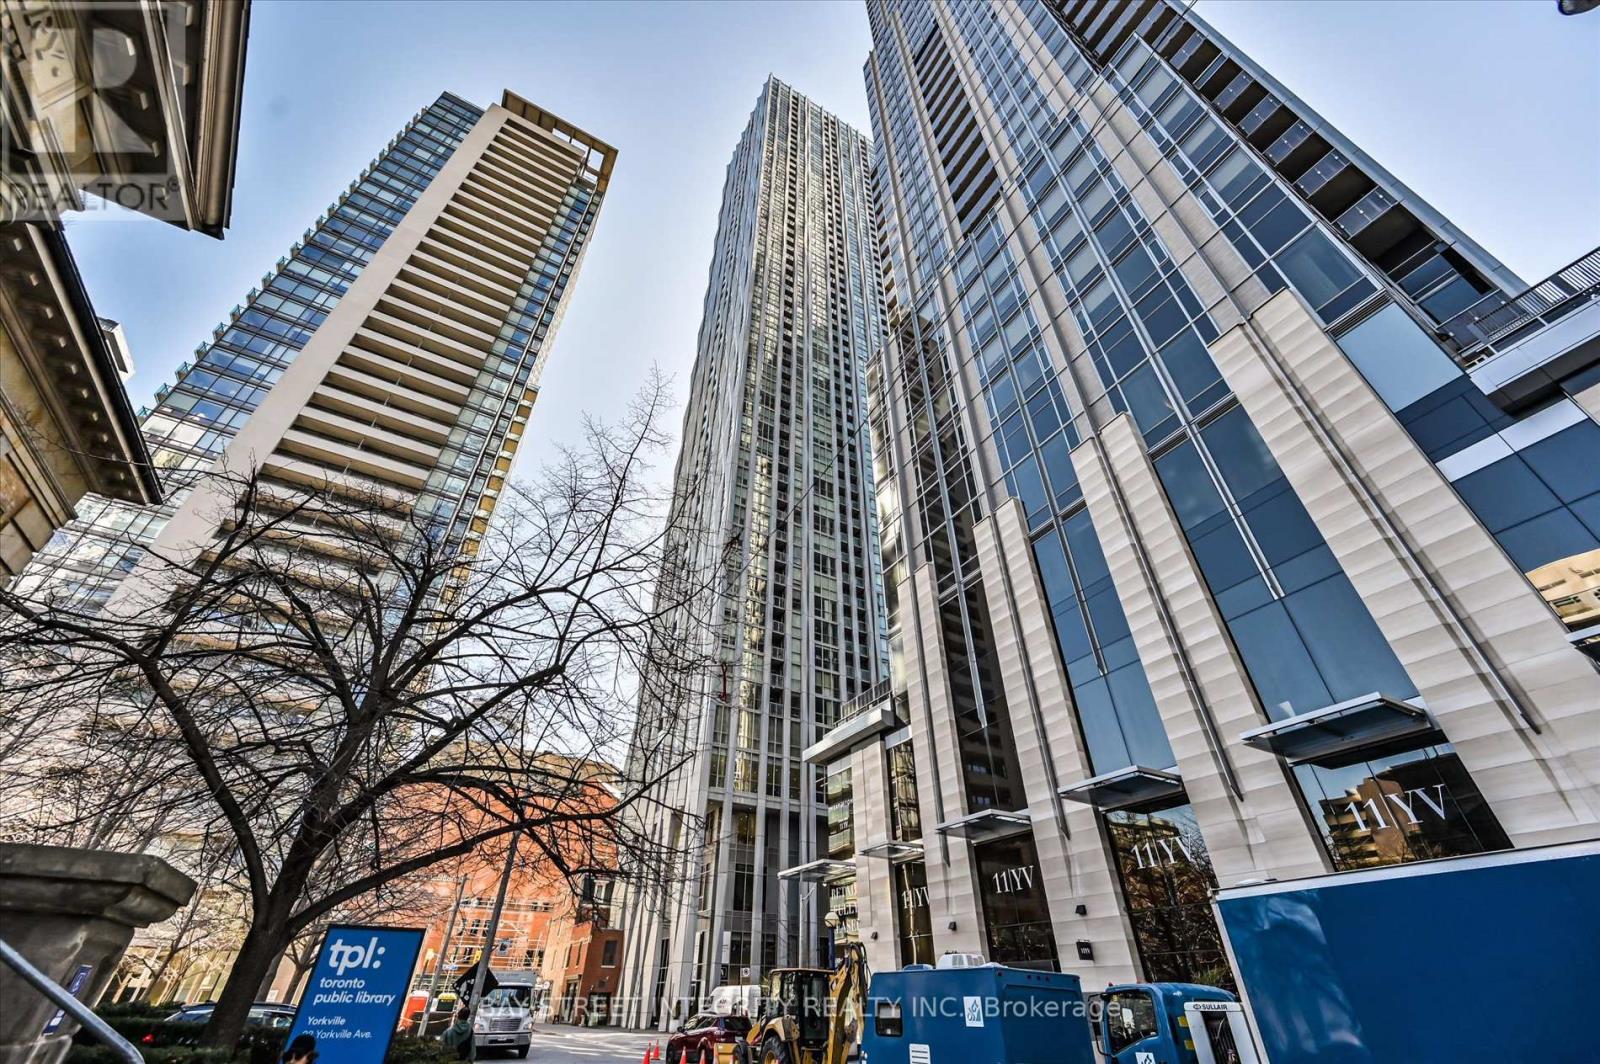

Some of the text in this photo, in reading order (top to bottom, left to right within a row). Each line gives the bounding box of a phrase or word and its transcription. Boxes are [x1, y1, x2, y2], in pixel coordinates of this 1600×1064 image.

[319, 977, 365, 989] toronto
[313, 990, 397, 1007] public library
[307, 1015, 346, 1026] Yorkville
[316, 1029, 352, 1039] Yorkville
[352, 1029, 373, 1039] Ave.
